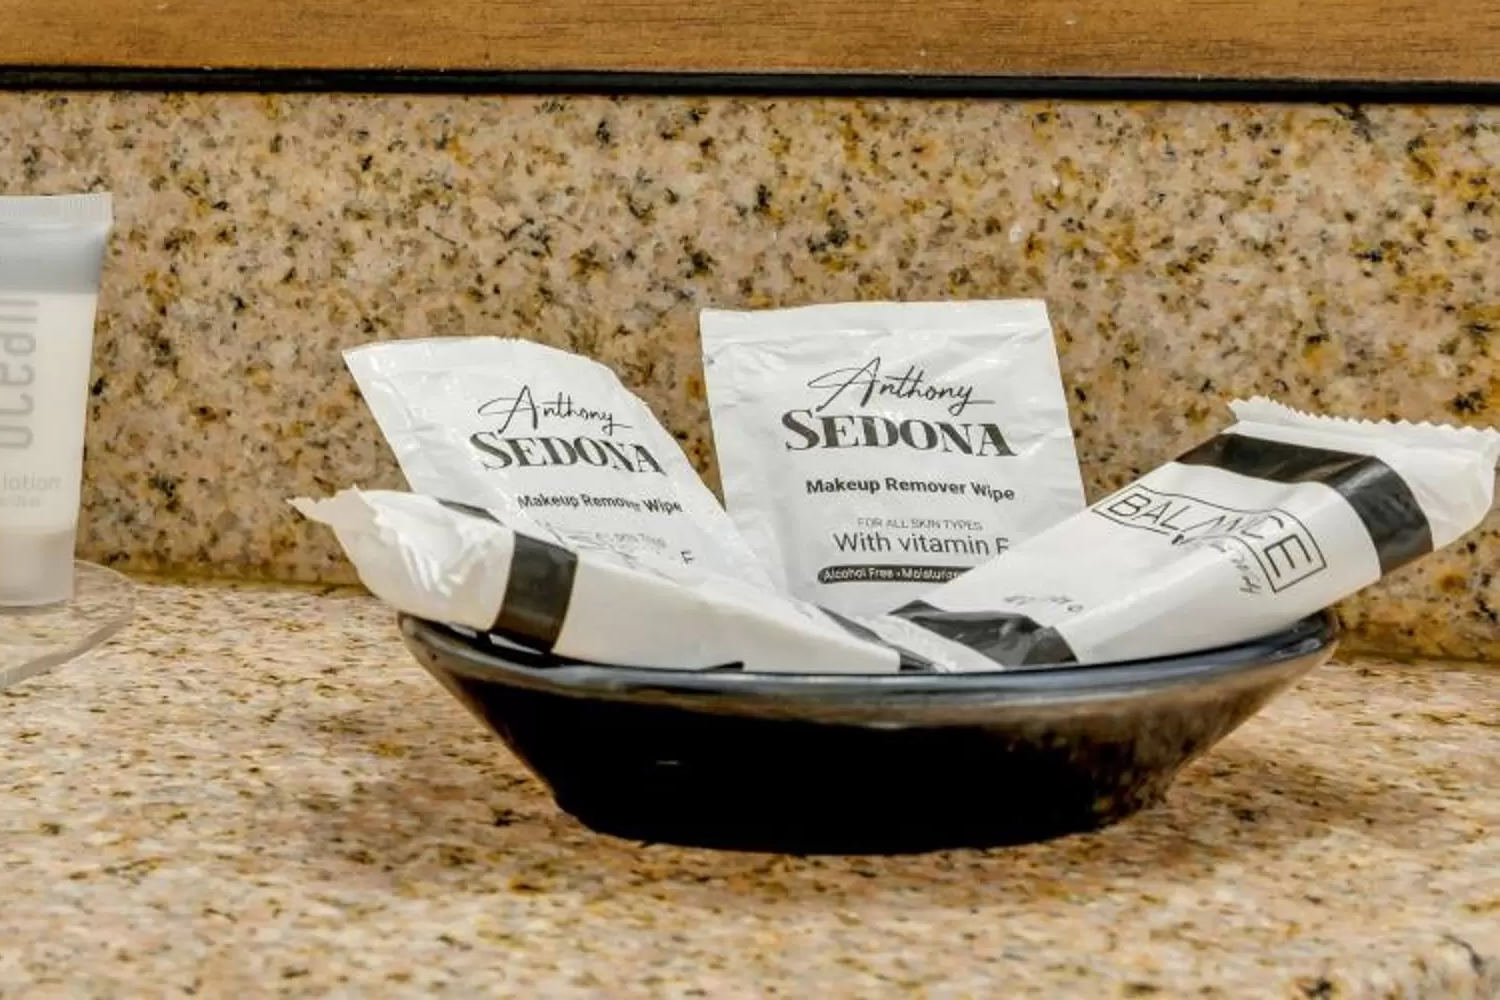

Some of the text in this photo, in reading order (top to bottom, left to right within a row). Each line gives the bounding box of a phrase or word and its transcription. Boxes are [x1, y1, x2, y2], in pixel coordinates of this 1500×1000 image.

[806, 356, 996, 416] Anthony
[477, 384, 633, 436] Anthony
[780, 408, 1018, 458] SEDONA
[469, 431, 668, 478] SEDONA
[2, 471, 62, 492] lotion
[805, 477, 1016, 503] Makeup Remover Wipe
[517, 493, 579, 511] Makeup
[643, 498, 683, 515] Wipe
[857, 517, 984, 531] FOR ALL SKIN TYPES
[833, 532, 892, 552] With
[899, 534, 989, 555] vitamin
[823, 567, 867, 581] Alcohol
[869, 567, 895, 580] Free
